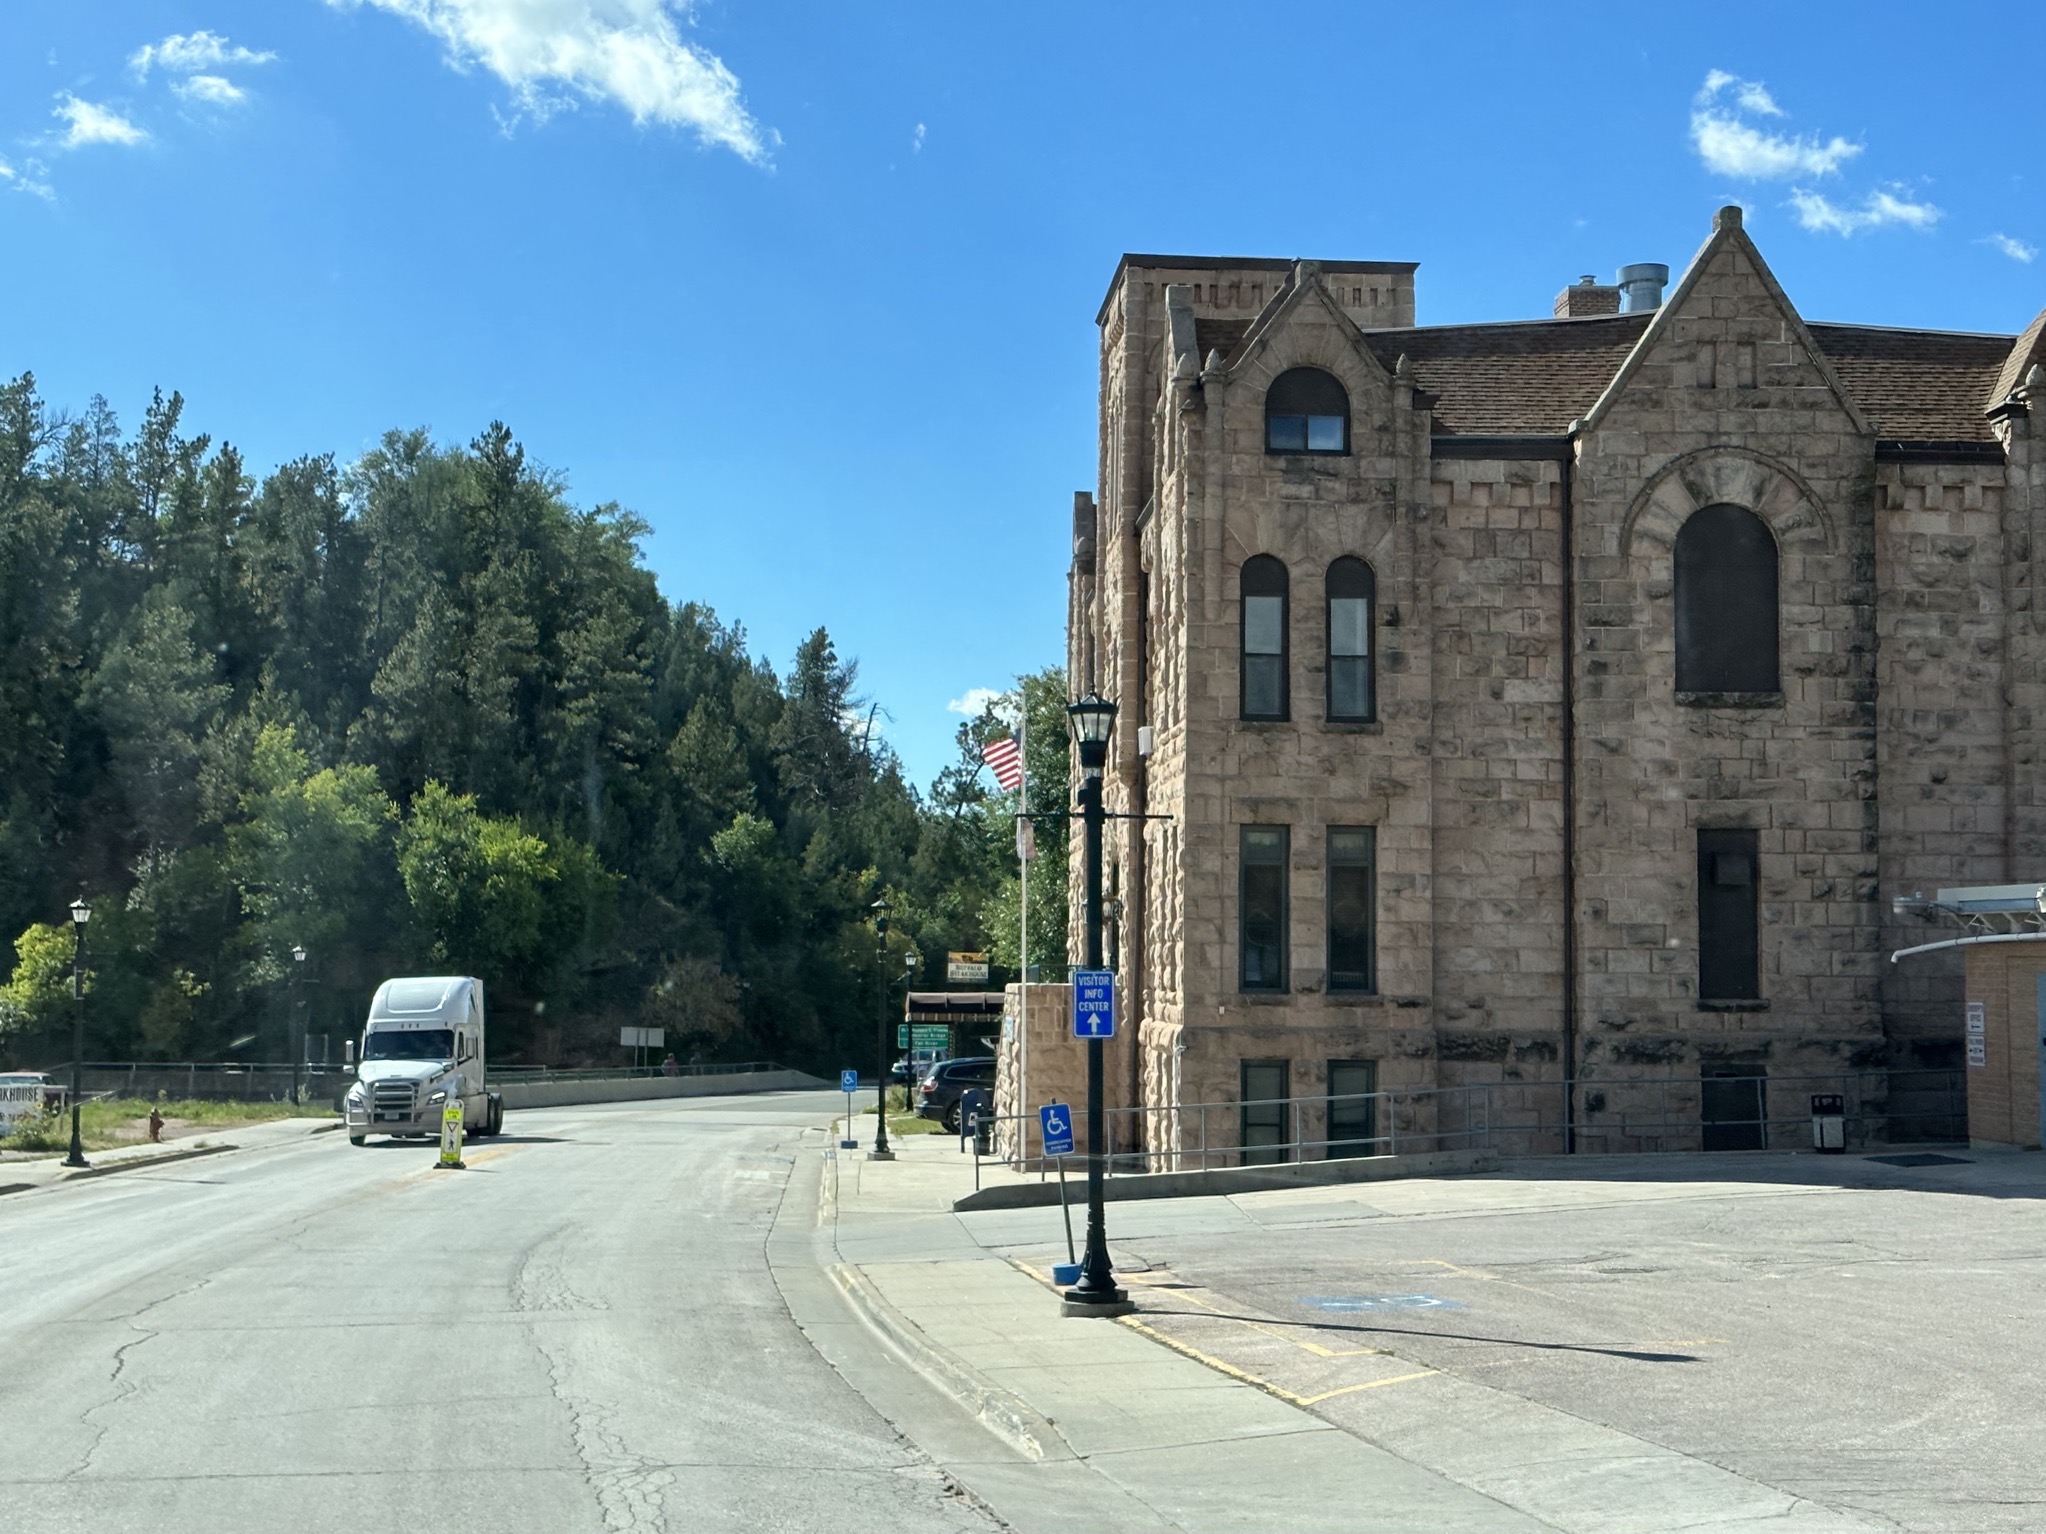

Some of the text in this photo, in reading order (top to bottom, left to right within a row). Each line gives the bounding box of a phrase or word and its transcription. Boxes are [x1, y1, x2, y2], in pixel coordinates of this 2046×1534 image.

[1078, 976, 1110, 986] VISITOR
[1084, 989, 1103, 999] INFO
[1078, 1001, 1109, 1012] CENTER
